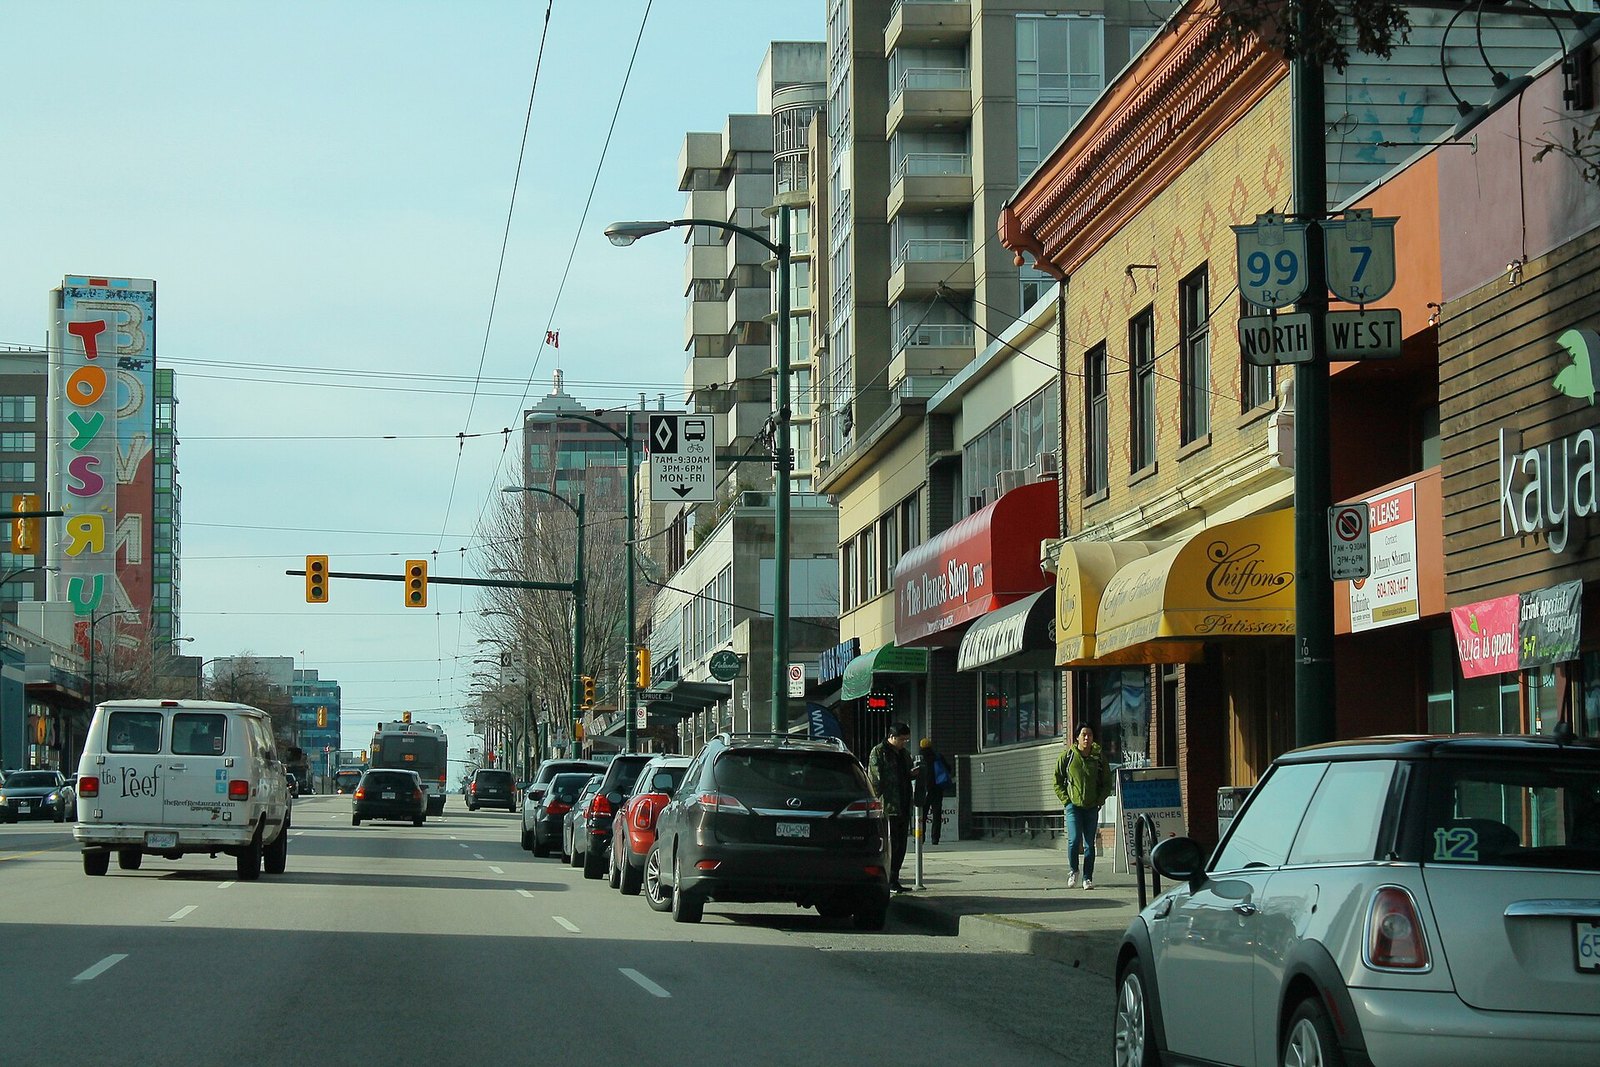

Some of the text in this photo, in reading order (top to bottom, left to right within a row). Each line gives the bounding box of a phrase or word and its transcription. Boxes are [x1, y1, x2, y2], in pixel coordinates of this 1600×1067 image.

[1247, 249, 1299, 287] 99
[1350, 246, 1373, 282] 7
[1244, 323, 1308, 355] NORTH
[1332, 321, 1395, 349] WEST
[66, 319, 107, 498] TOYS
[660, 474, 705, 482] MON-FRI
[1499, 428, 1598, 554] kaya
[1377, 498, 1400, 526] LEASE
[1205, 541, 1295, 602] Chiffon
[1373, 550, 1411, 574] Johnny Sharma
[906, 579, 921, 617] The
[922, 572, 947, 611] Dance
[948, 558, 969, 604] Shop
[1194, 613, 1296, 634] Patisserie
[1520, 597, 1540, 622] drink
[1457, 633, 1480, 668] kaya
[1482, 629, 1490, 659] is
[1491, 623, 1515, 666] open!
[101, 764, 162, 798] the reef
